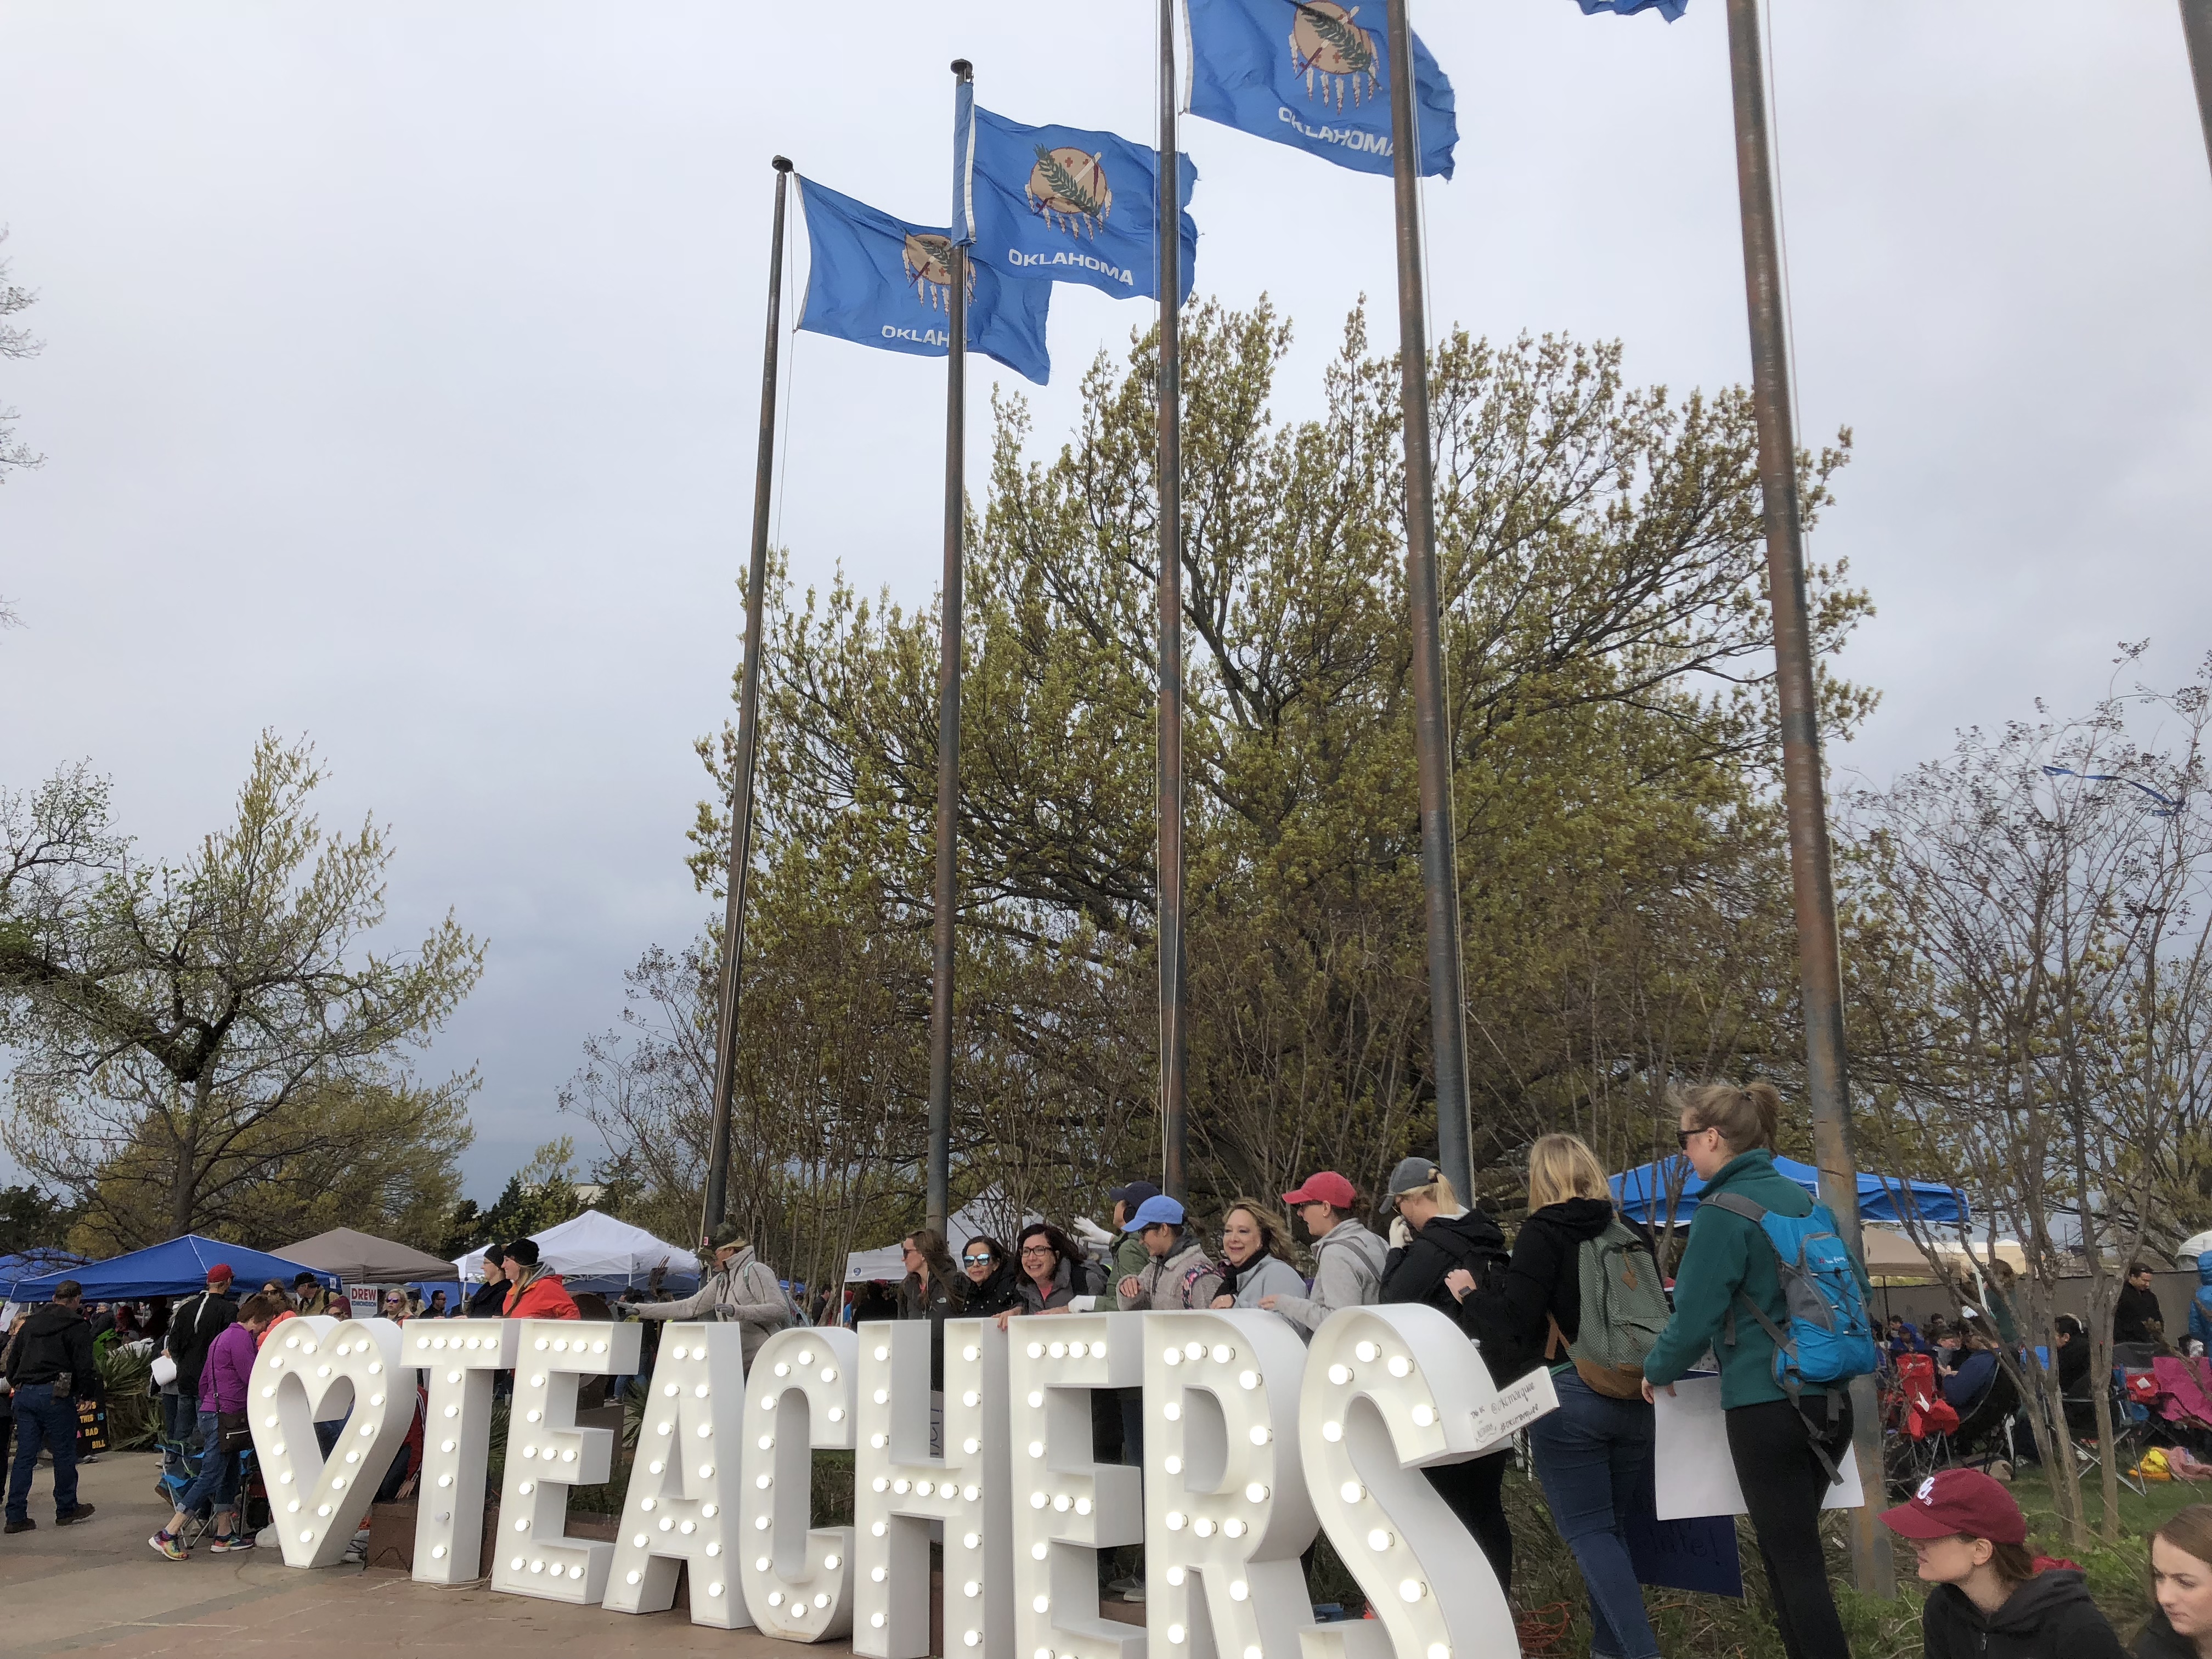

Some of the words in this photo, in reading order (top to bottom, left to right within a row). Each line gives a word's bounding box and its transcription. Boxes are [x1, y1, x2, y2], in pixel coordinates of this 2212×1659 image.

[1009, 249, 1133, 286] OKLAHOMA
[352, 1288, 376, 1301] DREW
[80, 1414, 94, 1424] THIS
[85, 1427, 99, 1436] BAD
[92, 1440, 105, 1449] BILL
[400, 1304, 1559, 1659] TEACHERS
